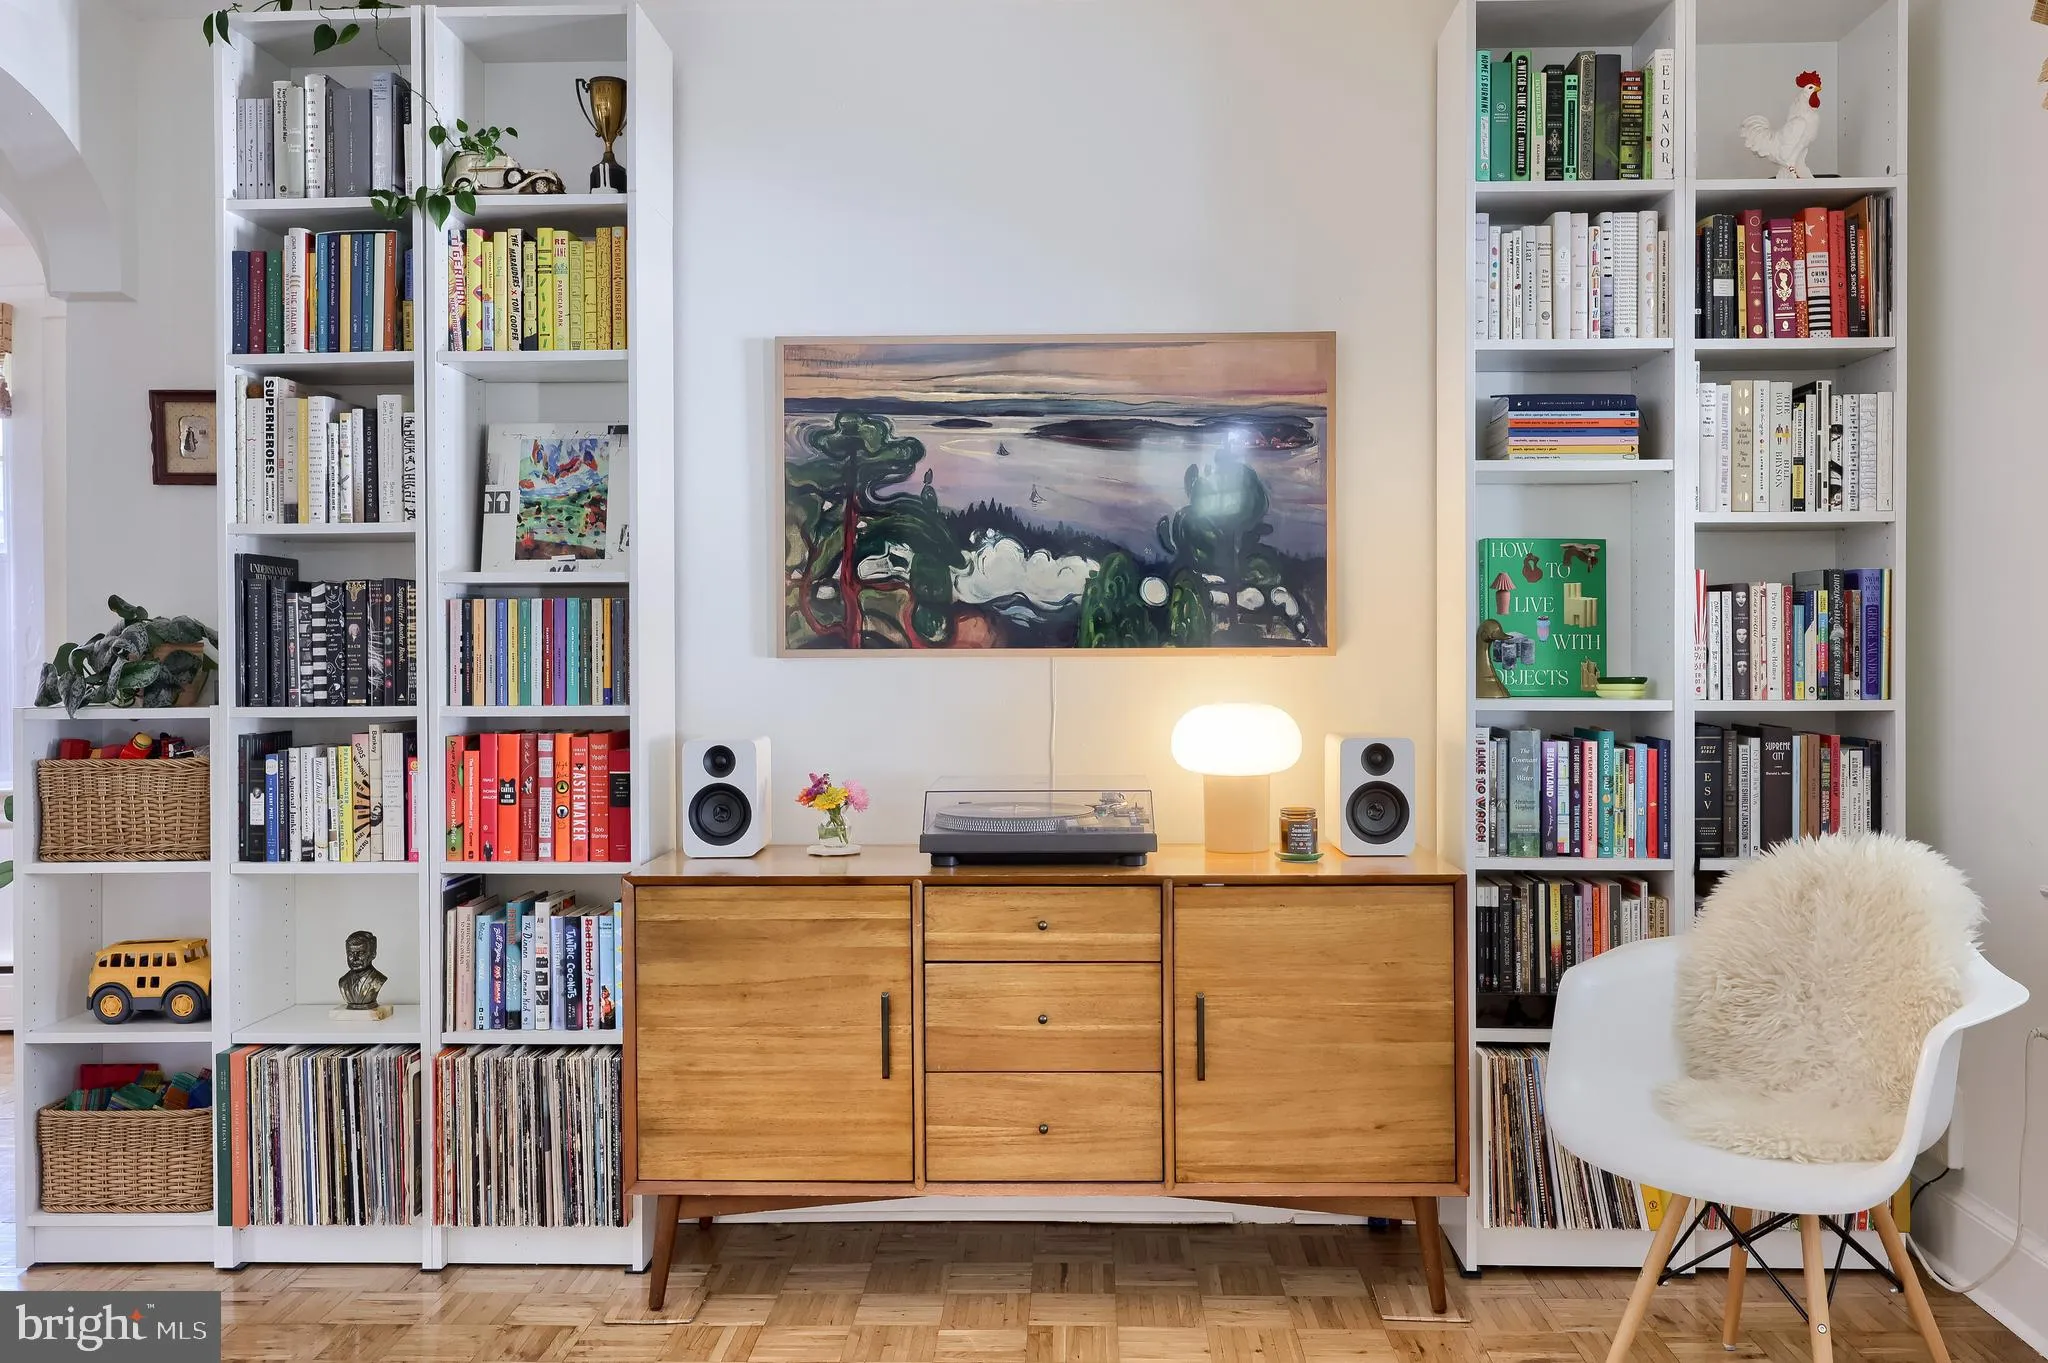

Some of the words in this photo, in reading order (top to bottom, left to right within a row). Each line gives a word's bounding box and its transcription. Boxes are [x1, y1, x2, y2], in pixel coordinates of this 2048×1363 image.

[1518, 65, 1526, 85] WITCH
[1518, 93, 1526, 108] LIME
[1518, 110, 1526, 134] STREET
[511, 234, 519, 247] THE
[1526, 241, 1534, 262] Liar
[451, 236, 466, 306] TIGERMAN
[509, 248, 520, 287] MARAUDERS
[510, 315, 519, 341] COOPER
[265, 380, 274, 478] SUPERHEROES!
[367, 446, 372, 454] TO
[1492, 542, 1534, 558] HOW
[249, 563, 294, 576] UNDERSTANDING
[1546, 562, 1570, 578] TO
[408, 588, 416, 610] JEFF
[1515, 596, 1555, 613] LIVE
[1867, 607, 1878, 638] GEORGE
[408, 616, 416, 658] TWEEDY
[1553, 634, 1600, 650] WITH
[1867, 642, 1878, 684] SAUNDERS
[355, 743, 366, 759] GODS
[1588, 747, 1592, 756] MY
[1765, 742, 1790, 750] SUPREME
[1772, 751, 1784, 760] CITY
[354, 757, 368, 777] WITHOUT
[1476, 748, 1486, 774] LIKE
[1546, 747, 1554, 797] BEAUTYLAND
[1476, 778, 1486, 794] TO
[573, 766, 586, 841] TASTEMAKER
[1476, 797, 1486, 842] WATCH
[508, 908, 517, 923] BEN
[494, 928, 502, 941] Bill
[566, 929, 576, 959] TANTRIC
[494, 942, 502, 963] Bryson
[523, 933, 533, 958] Dinner
